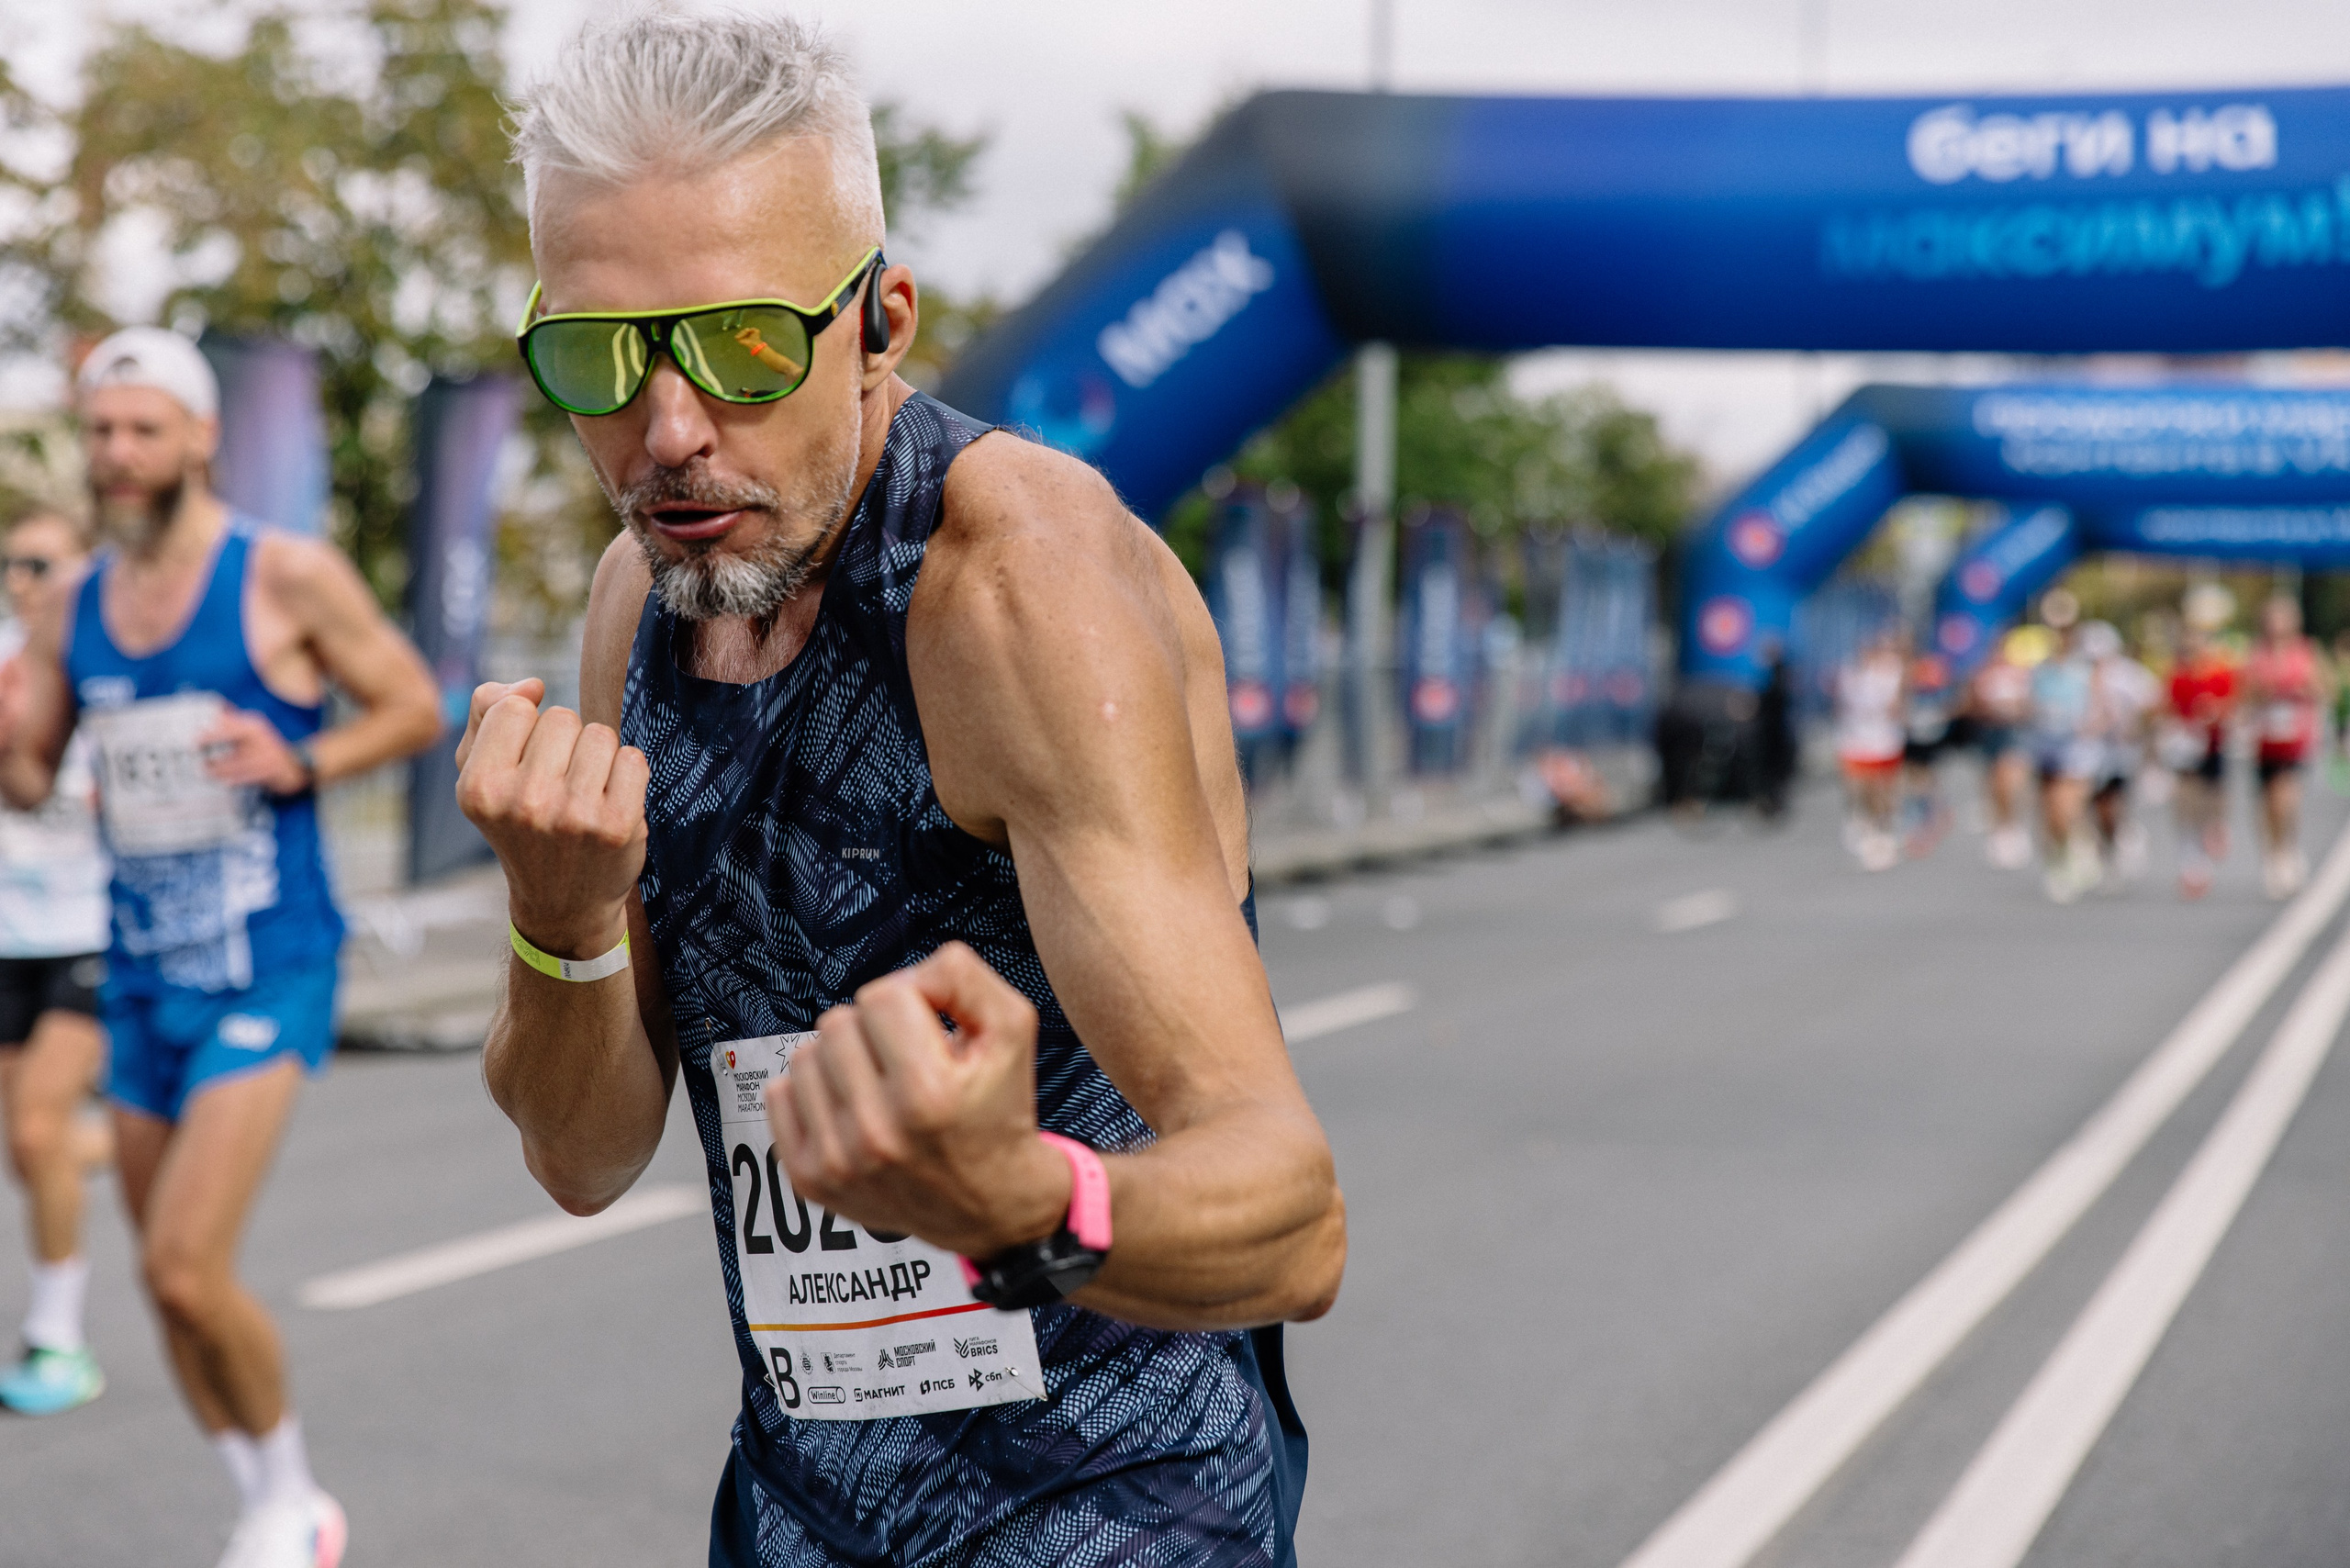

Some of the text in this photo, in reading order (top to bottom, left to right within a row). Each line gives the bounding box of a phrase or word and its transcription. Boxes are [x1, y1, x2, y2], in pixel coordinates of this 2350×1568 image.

[1906, 103, 2278, 184] беги на
[841, 847, 880, 860] KIPRUN
[733, 1069, 769, 1081] МОСКОВСКИЙ
[736, 1082, 761, 1092] МАРАФОН
[738, 1092, 757, 1102] MOSCOW
[738, 1103, 767, 1113] MARATHON
[789, 1260, 931, 1305] АЛЕКСАНДР
[893, 1338, 936, 1357] МОСКОВСКИЙ
[970, 1344, 999, 1358] BRICS
[896, 1355, 916, 1368] СПОРТ
[769, 1347, 801, 1409] B
[985, 1372, 1002, 1382] сбп
[863, 1384, 906, 1400] МАГНИТ
[933, 1379, 956, 1392] ПСБ
[811, 1390, 836, 1400] Winline
